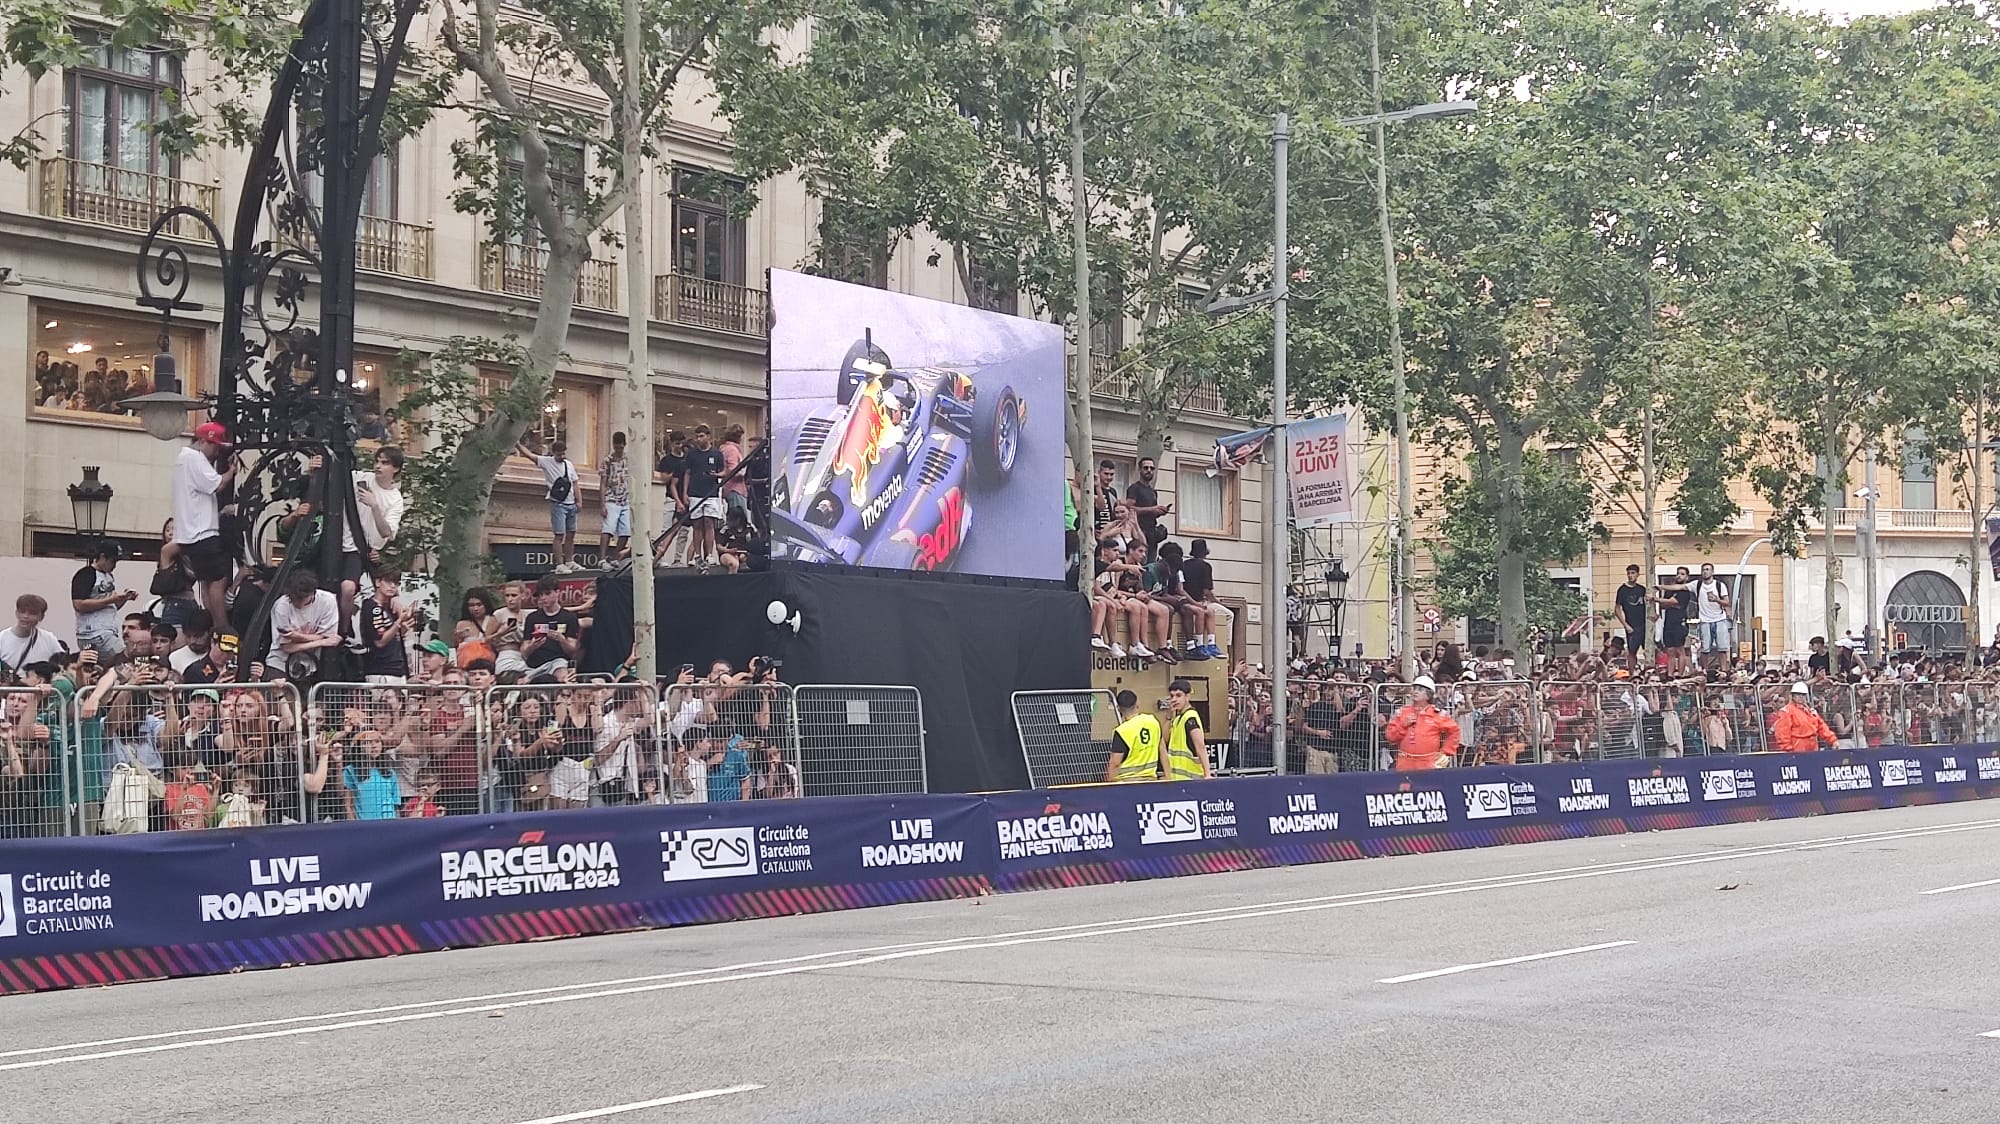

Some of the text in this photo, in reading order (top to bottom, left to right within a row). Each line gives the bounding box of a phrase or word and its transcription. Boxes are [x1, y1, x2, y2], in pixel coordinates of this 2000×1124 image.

[1295, 452, 1339, 475] JUNY
[861, 474, 902, 530] movento
[525, 552, 598, 566] EDICIO
[1884, 604, 1964, 623] COMEDI
[1571, 778, 1593, 794] LIVE
[1628, 777, 1688, 796] BARCELONA
[1772, 780, 1811, 796] ROADSHOW
[1201, 799, 1235, 813] Circuit de
[1287, 793, 1317, 812] LIVE
[1365, 790, 1446, 814] BARCELONA
[1559, 794, 1610, 813] ROADSHOW
[890, 818, 933, 841] LIVE
[997, 812, 1111, 843] BARCELONA
[1202, 813, 1236, 826] Barcelona
[1269, 812, 1339, 834] ROADSHOW
[1368, 809, 1448, 828] FAN FESTIVAL 2024
[758, 824, 809, 843] Circuit de
[1204, 827, 1238, 839] CATALUNYA
[760, 841, 811, 858] Barcelona
[861, 841, 964, 867] ROADSHOW
[1000, 833, 1114, 860] FAN FESTIVAL 2024
[250, 855, 320, 886] LIVE
[440, 841, 618, 881] BARCELONA
[761, 859, 813, 875] CATALUNYA
[21, 869, 112, 893] Circuit de
[443, 866, 620, 901] FAN FESTIVAL 2024
[22, 890, 113, 915] Barcelona
[200, 882, 372, 922] ROADSHOW
[25, 914, 114, 936] CATALUNYA
